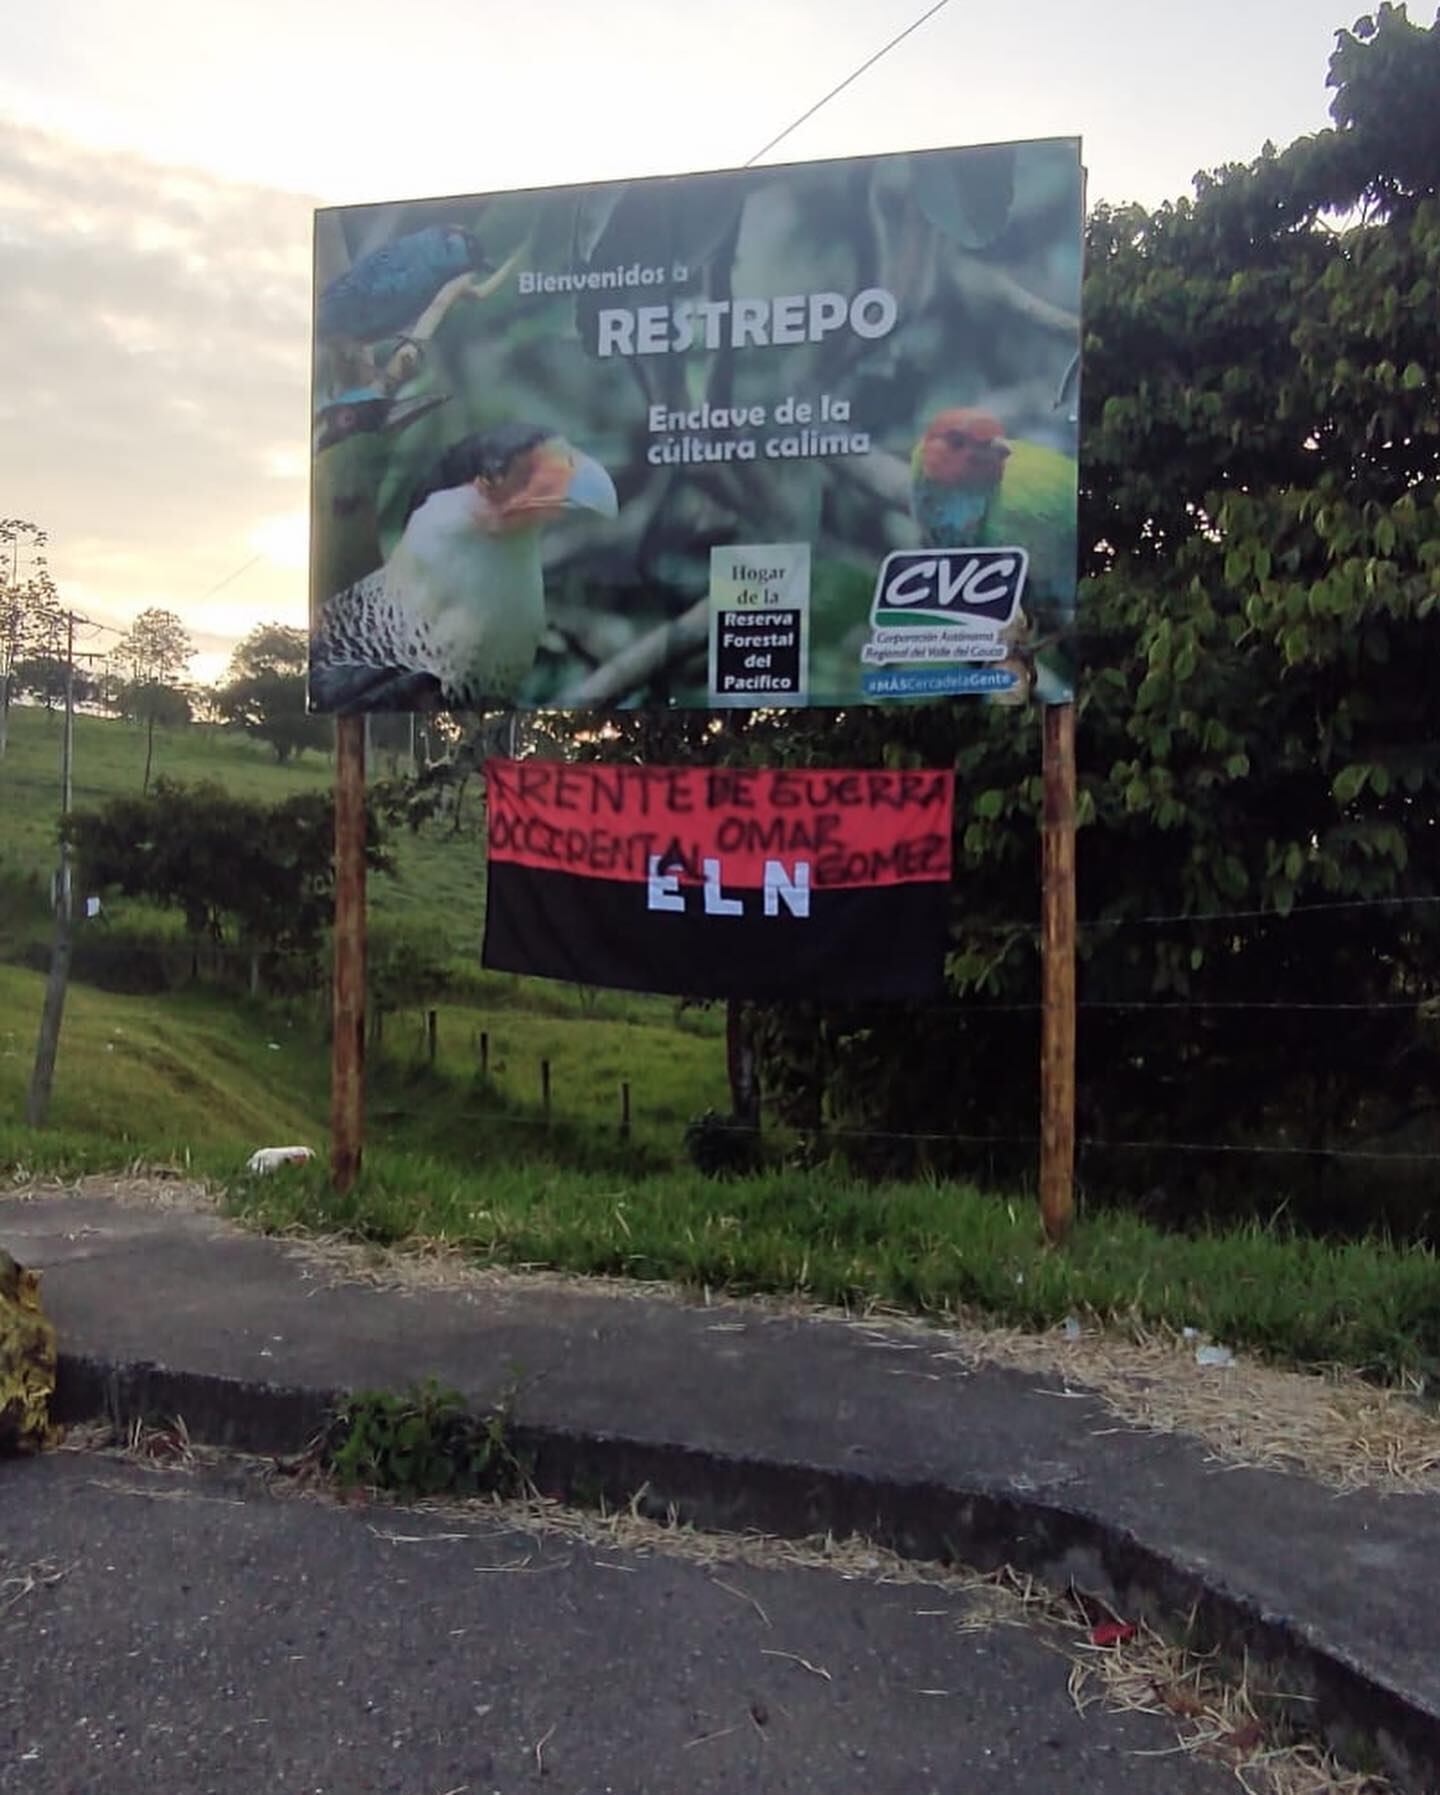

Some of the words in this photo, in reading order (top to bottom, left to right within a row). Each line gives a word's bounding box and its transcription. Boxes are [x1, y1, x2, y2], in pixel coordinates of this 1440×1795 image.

[518, 264, 665, 294] Bienvenidos
[672, 266, 689, 283] a
[599, 287, 898, 357] RESTREPO
[649, 404, 765, 432] Enclave
[775, 397, 812, 425] de
[820, 395, 850, 421] la
[765, 431, 871, 458] calima
[732, 565, 786, 583] Hogar
[886, 559, 1016, 606] CVC
[737, 589, 759, 605] de
[764, 589, 779, 605] la
[725, 613, 793, 626] Reserva
[723, 633, 794, 648] Forestal
[744, 654, 772, 668] del
[706, 772, 755, 808] DE
[767, 772, 946, 809] GUERRA
[717, 814, 841, 854] OMAR
